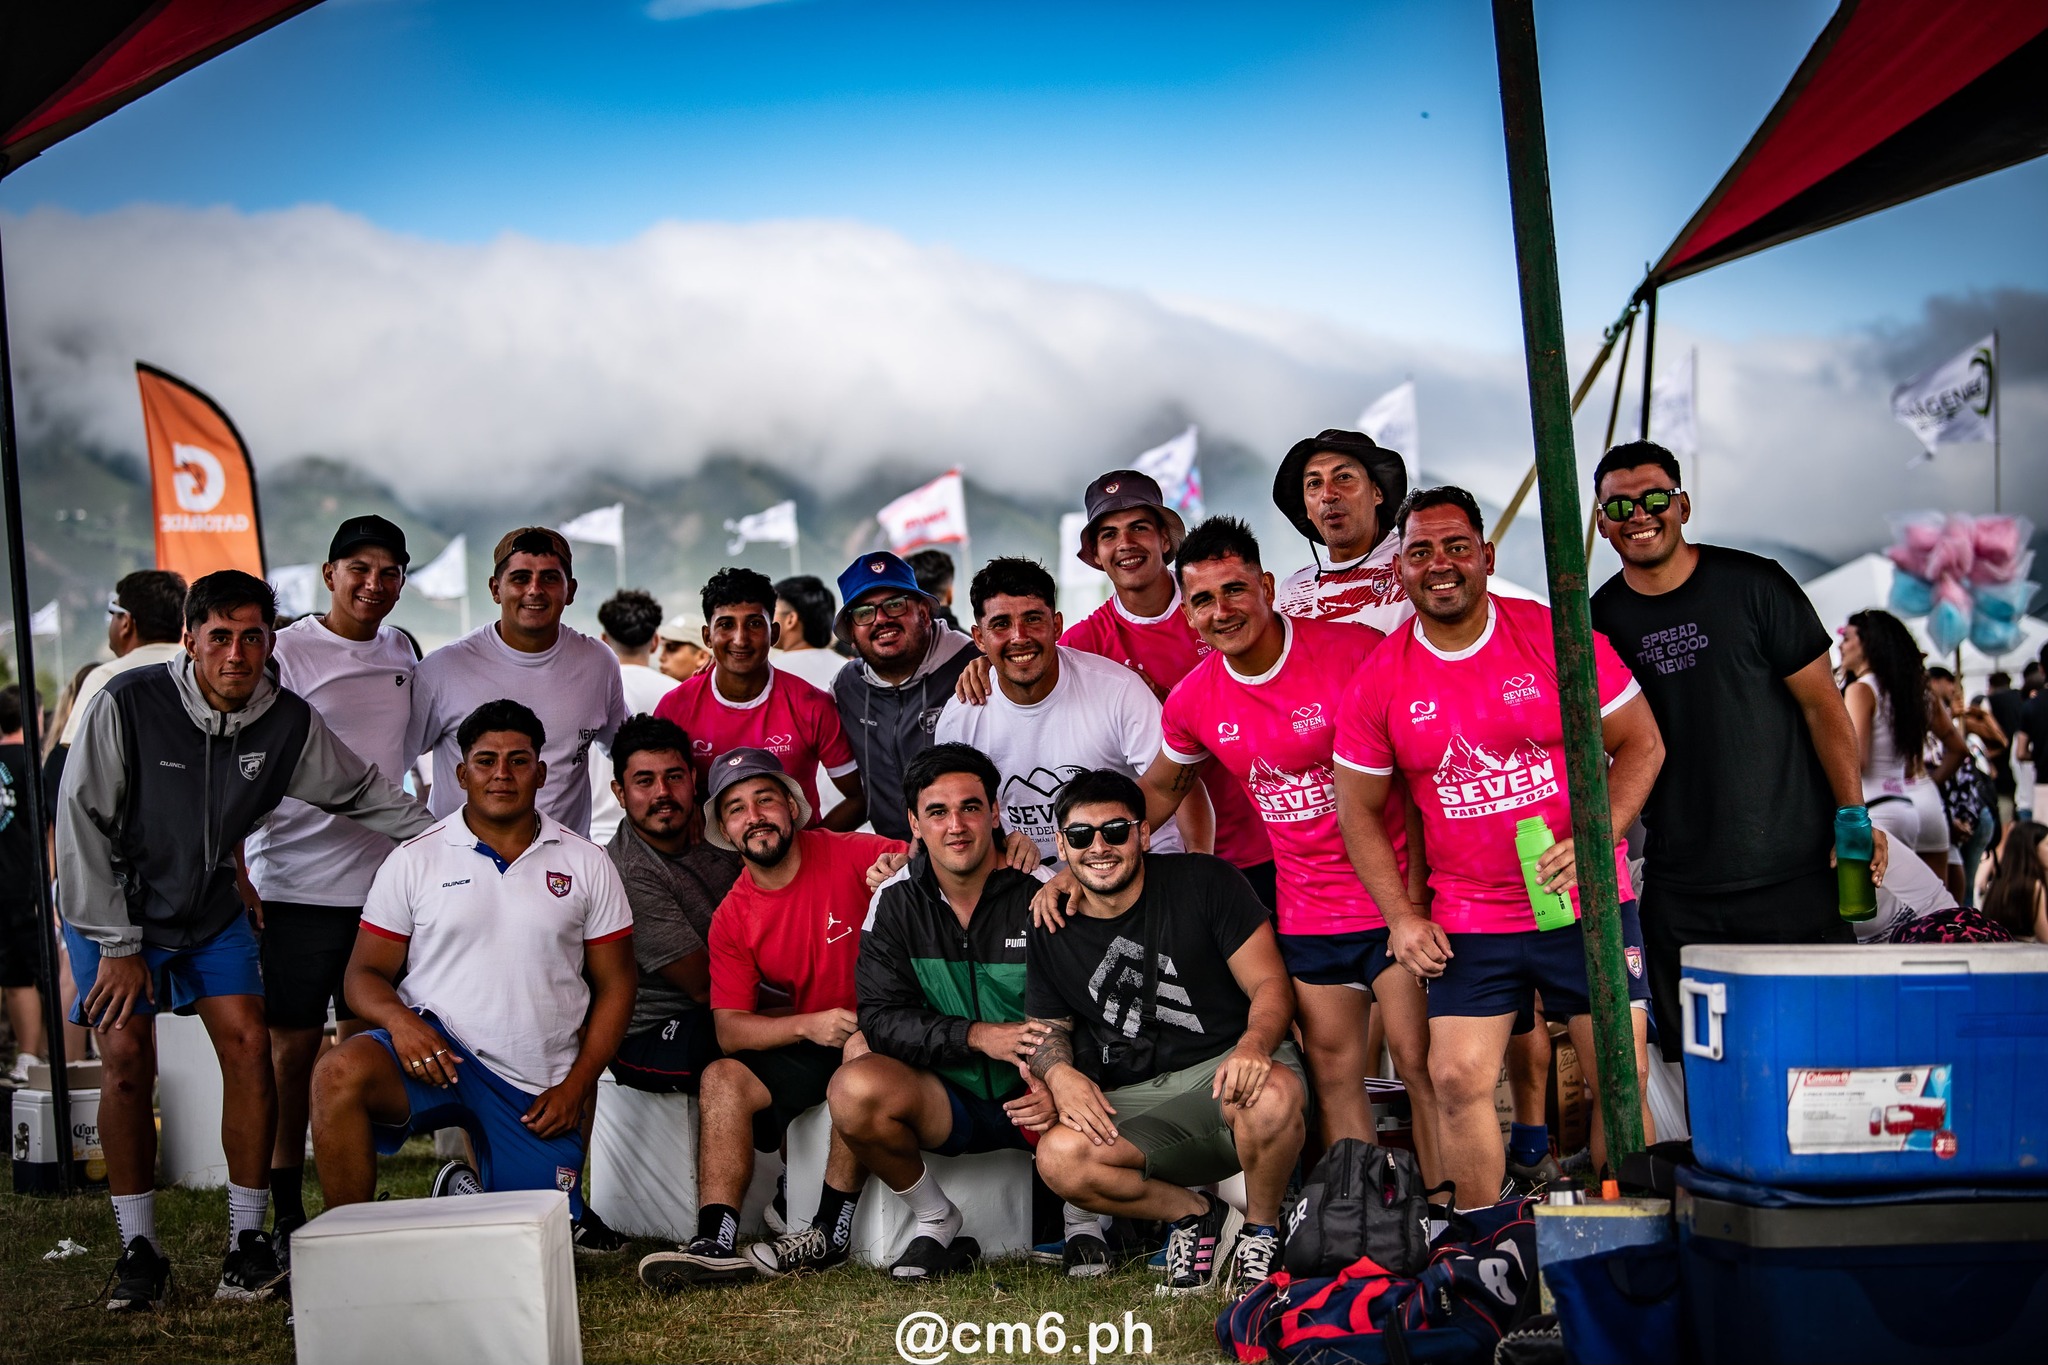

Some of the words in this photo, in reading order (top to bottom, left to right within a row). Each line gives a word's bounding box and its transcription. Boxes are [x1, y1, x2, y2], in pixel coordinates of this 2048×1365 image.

[1641, 622, 1698, 649] SPREAD
[1197, 645, 1212, 656] SEV
[1636, 646, 1665, 665] THE
[1666, 634, 1709, 657] GOOD
[1655, 653, 1697, 675] NEWS
[1503, 686, 1536, 701] SEVEN
[1292, 715, 1322, 730] SEVEN
[1411, 713, 1437, 724] quince
[1219, 734, 1240, 744] quince
[159, 760, 187, 770] QUINCE
[1436, 758, 1555, 806] SEVEN
[1450, 802, 1498, 818] PARTY
[1515, 785, 1554, 806] 2024
[1008, 803, 1055, 825] SEV
[1265, 812, 1299, 821] PARTY
[1036, 825, 1056, 836] DEL
[442, 878, 471, 888] QUINCE
[1807, 1072, 1841, 1084] Coleman
[73, 1123, 97, 1139] Cor
[832, 1200, 856, 1247] NIKESB
[716, 1212, 738, 1251] NIKES
